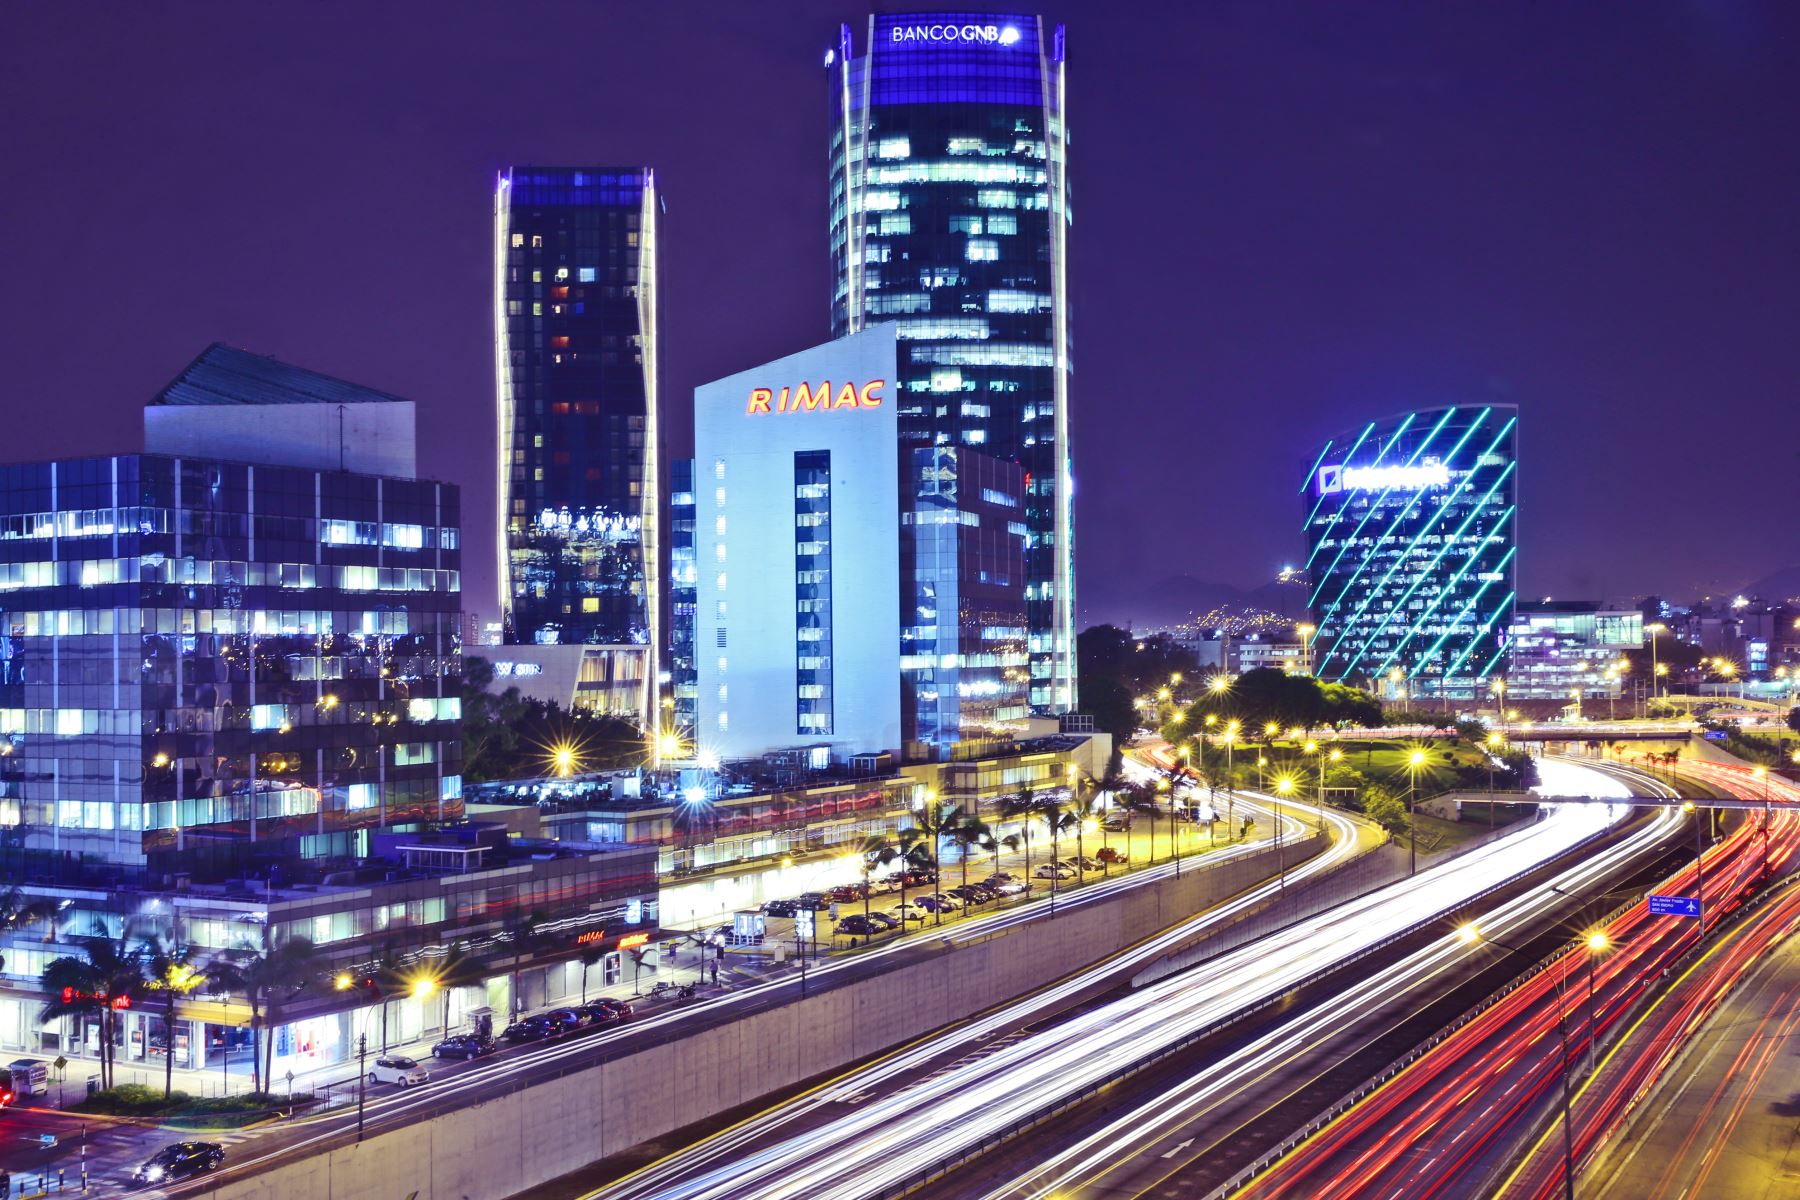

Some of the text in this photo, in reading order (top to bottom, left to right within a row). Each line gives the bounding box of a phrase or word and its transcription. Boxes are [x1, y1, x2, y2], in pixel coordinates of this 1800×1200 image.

[893, 25, 999, 41] BANCO GNB
[748, 379, 885, 414] RIMAC
